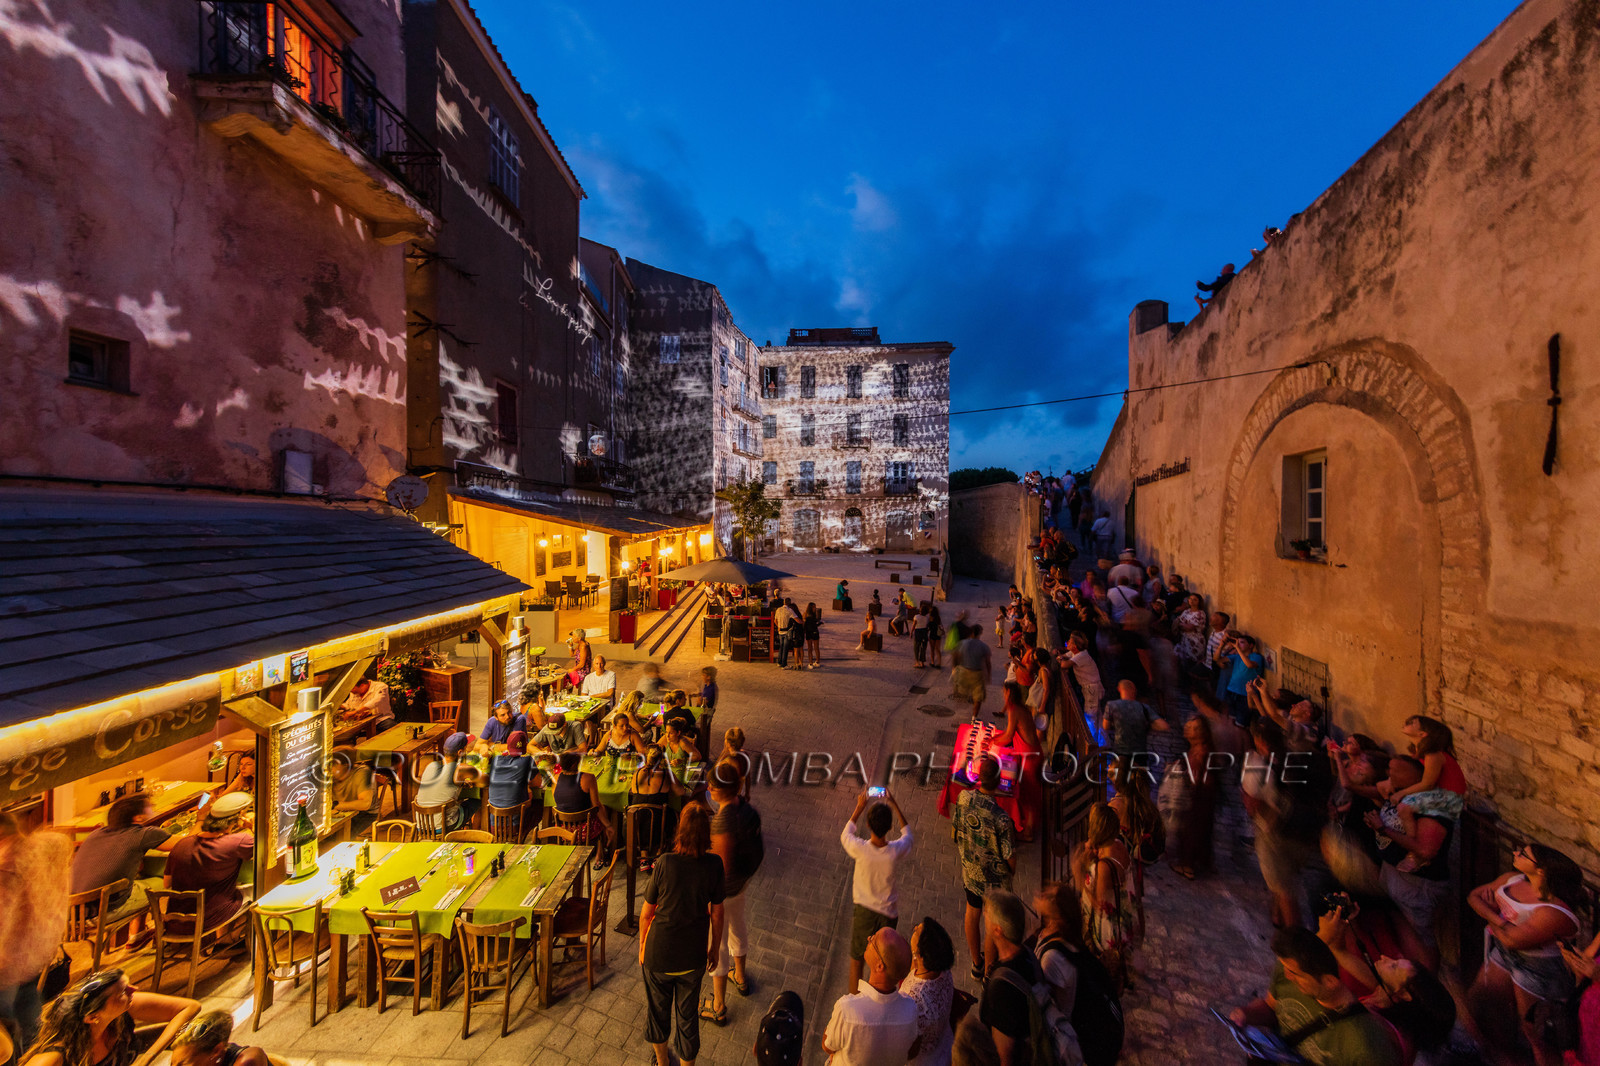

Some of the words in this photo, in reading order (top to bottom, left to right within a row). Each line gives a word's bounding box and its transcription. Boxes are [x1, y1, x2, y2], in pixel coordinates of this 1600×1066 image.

[94, 701, 208, 760] Corse
[282, 718, 322, 740] SPÉCIALITÉS
[285, 739, 296, 749] DU
[298, 730, 316, 743] CHEF
